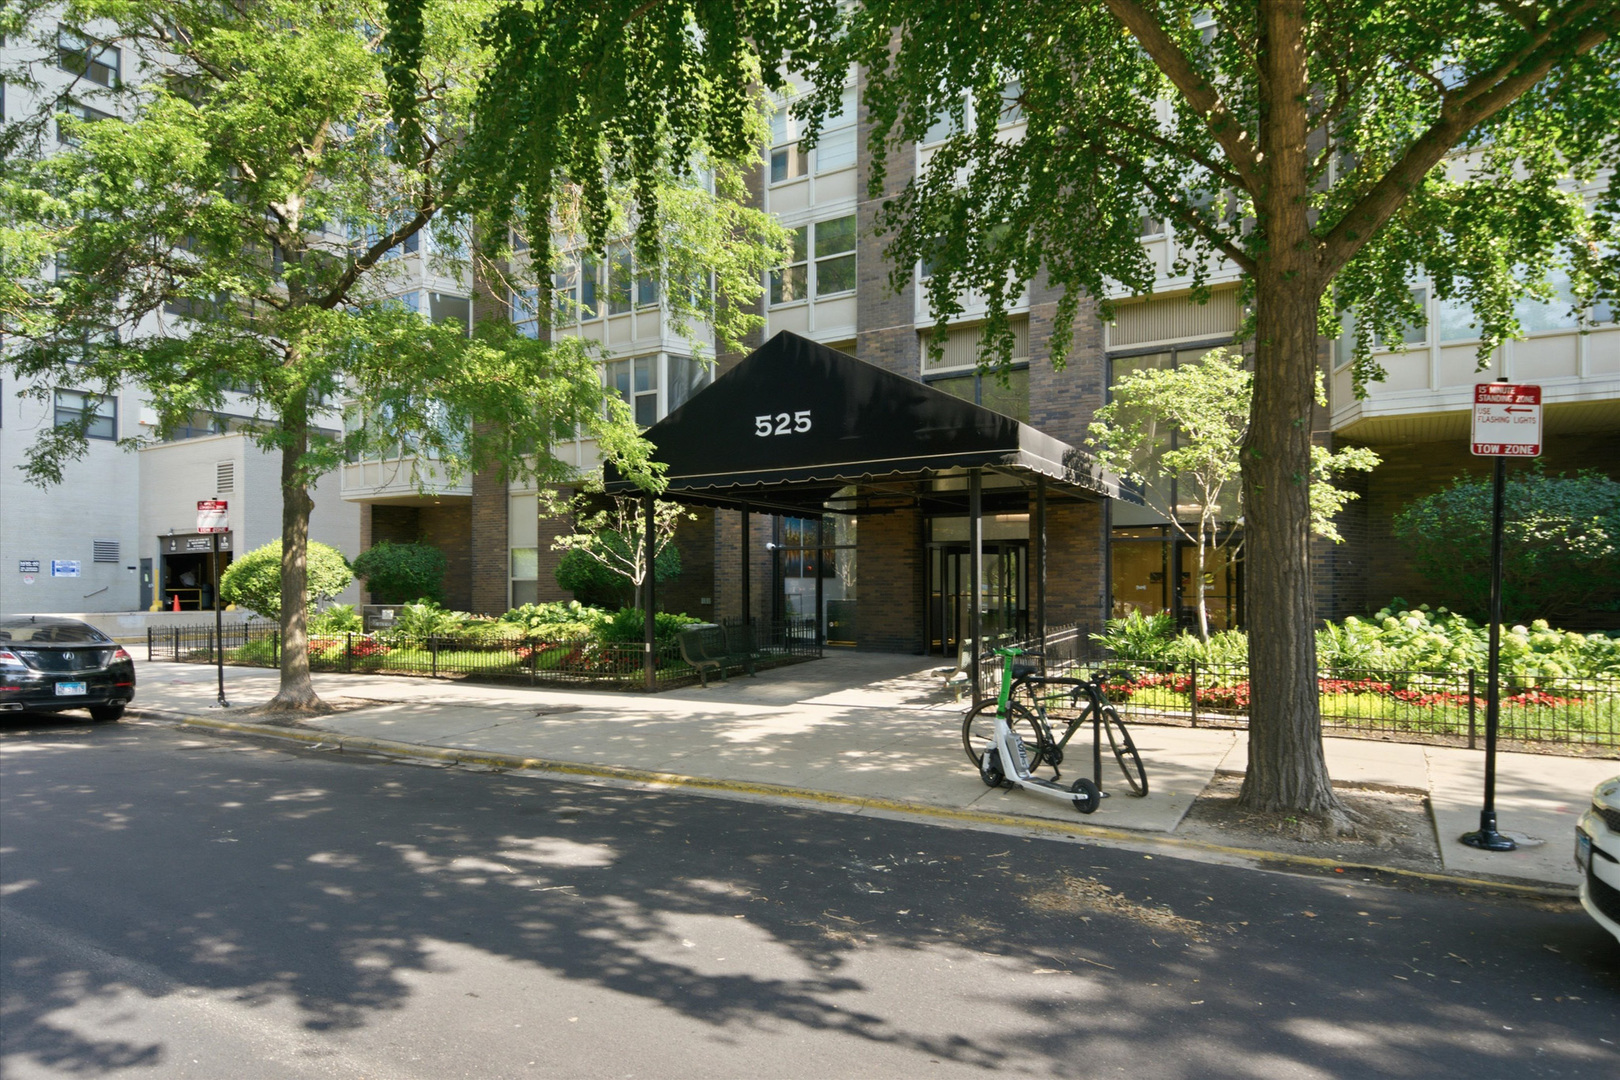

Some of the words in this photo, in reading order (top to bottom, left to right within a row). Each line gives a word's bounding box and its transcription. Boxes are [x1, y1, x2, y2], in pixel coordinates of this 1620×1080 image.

[1489, 386, 1516, 394] MINUTE
[1515, 395, 1535, 403] ZONE
[755, 410, 812, 437] 525
[1477, 445, 1499, 453] TOW
[1504, 445, 1534, 454] ZONE
